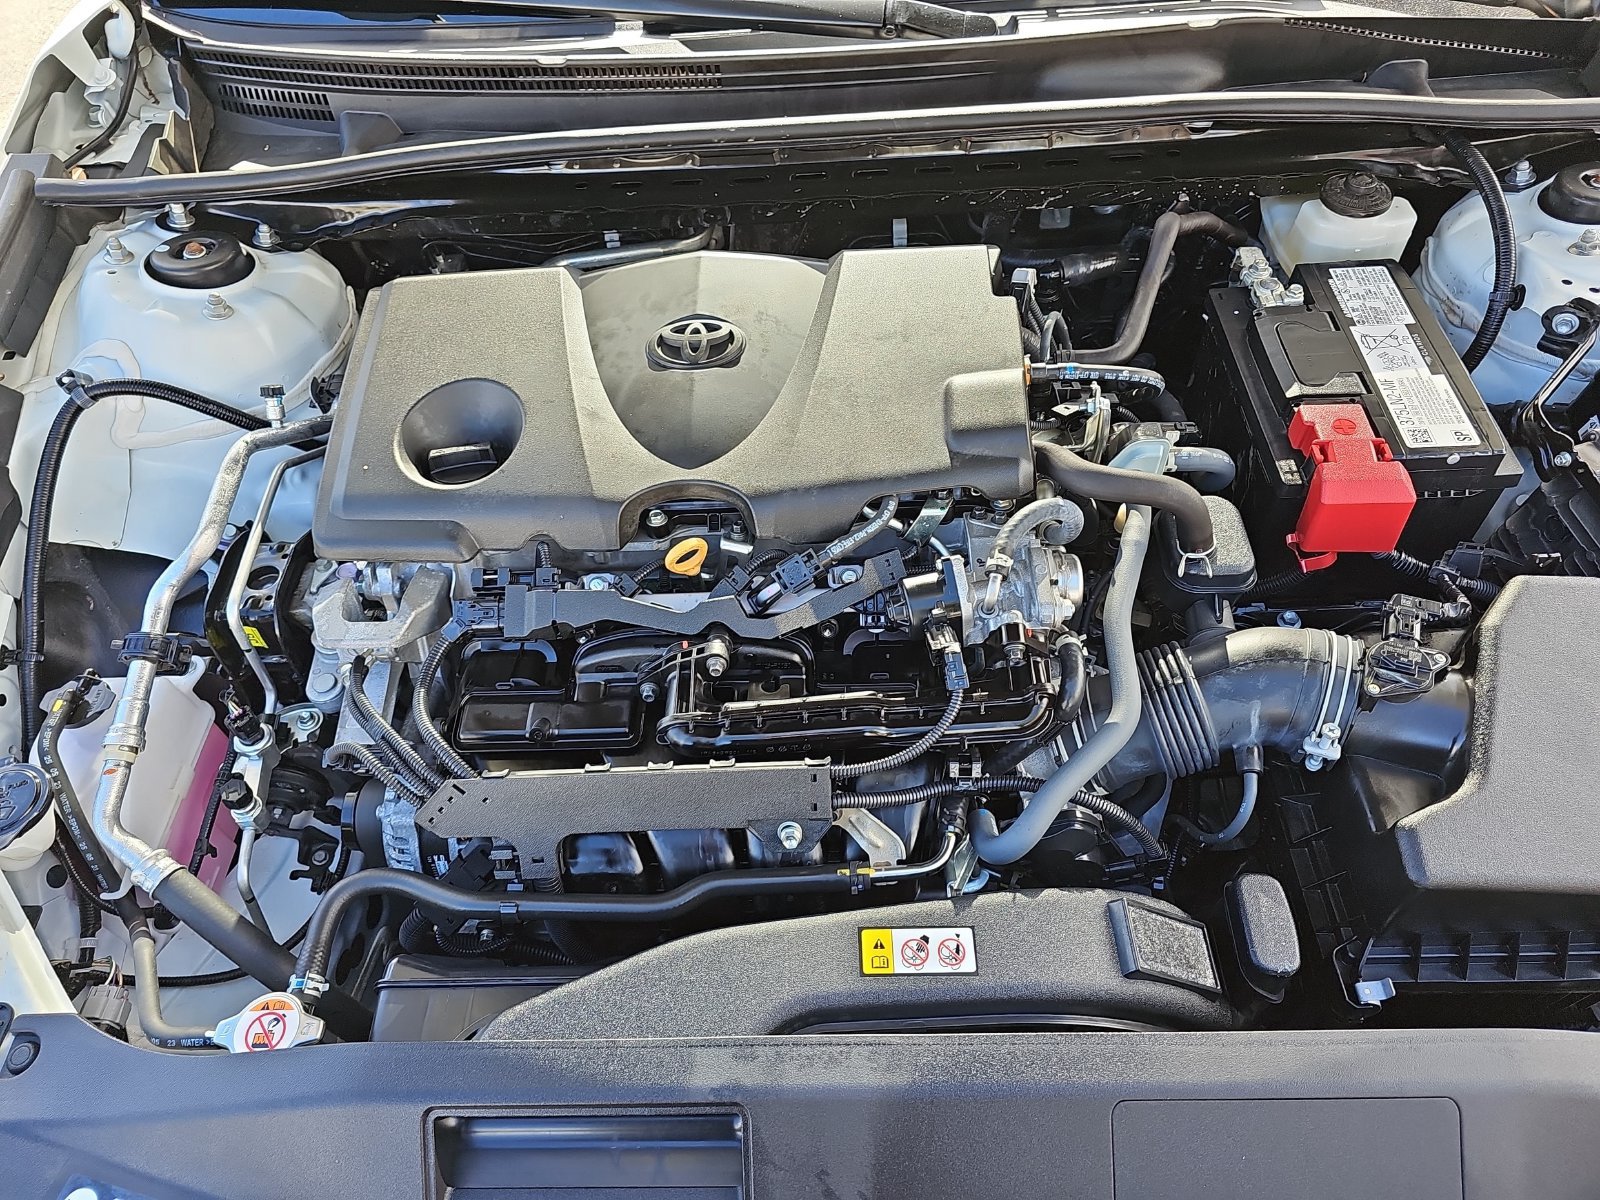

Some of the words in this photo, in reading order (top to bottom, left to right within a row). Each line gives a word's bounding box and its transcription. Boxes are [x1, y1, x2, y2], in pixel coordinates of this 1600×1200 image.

[1411, 333, 1429, 356] CLARIOS
[1379, 379, 1415, 426] 375LN2-MF
[1454, 431, 1472, 442] SP
[60, 792, 72, 817] WATER
[167, 1039, 176, 1047] 23
[180, 1038, 204, 1047] WATER
